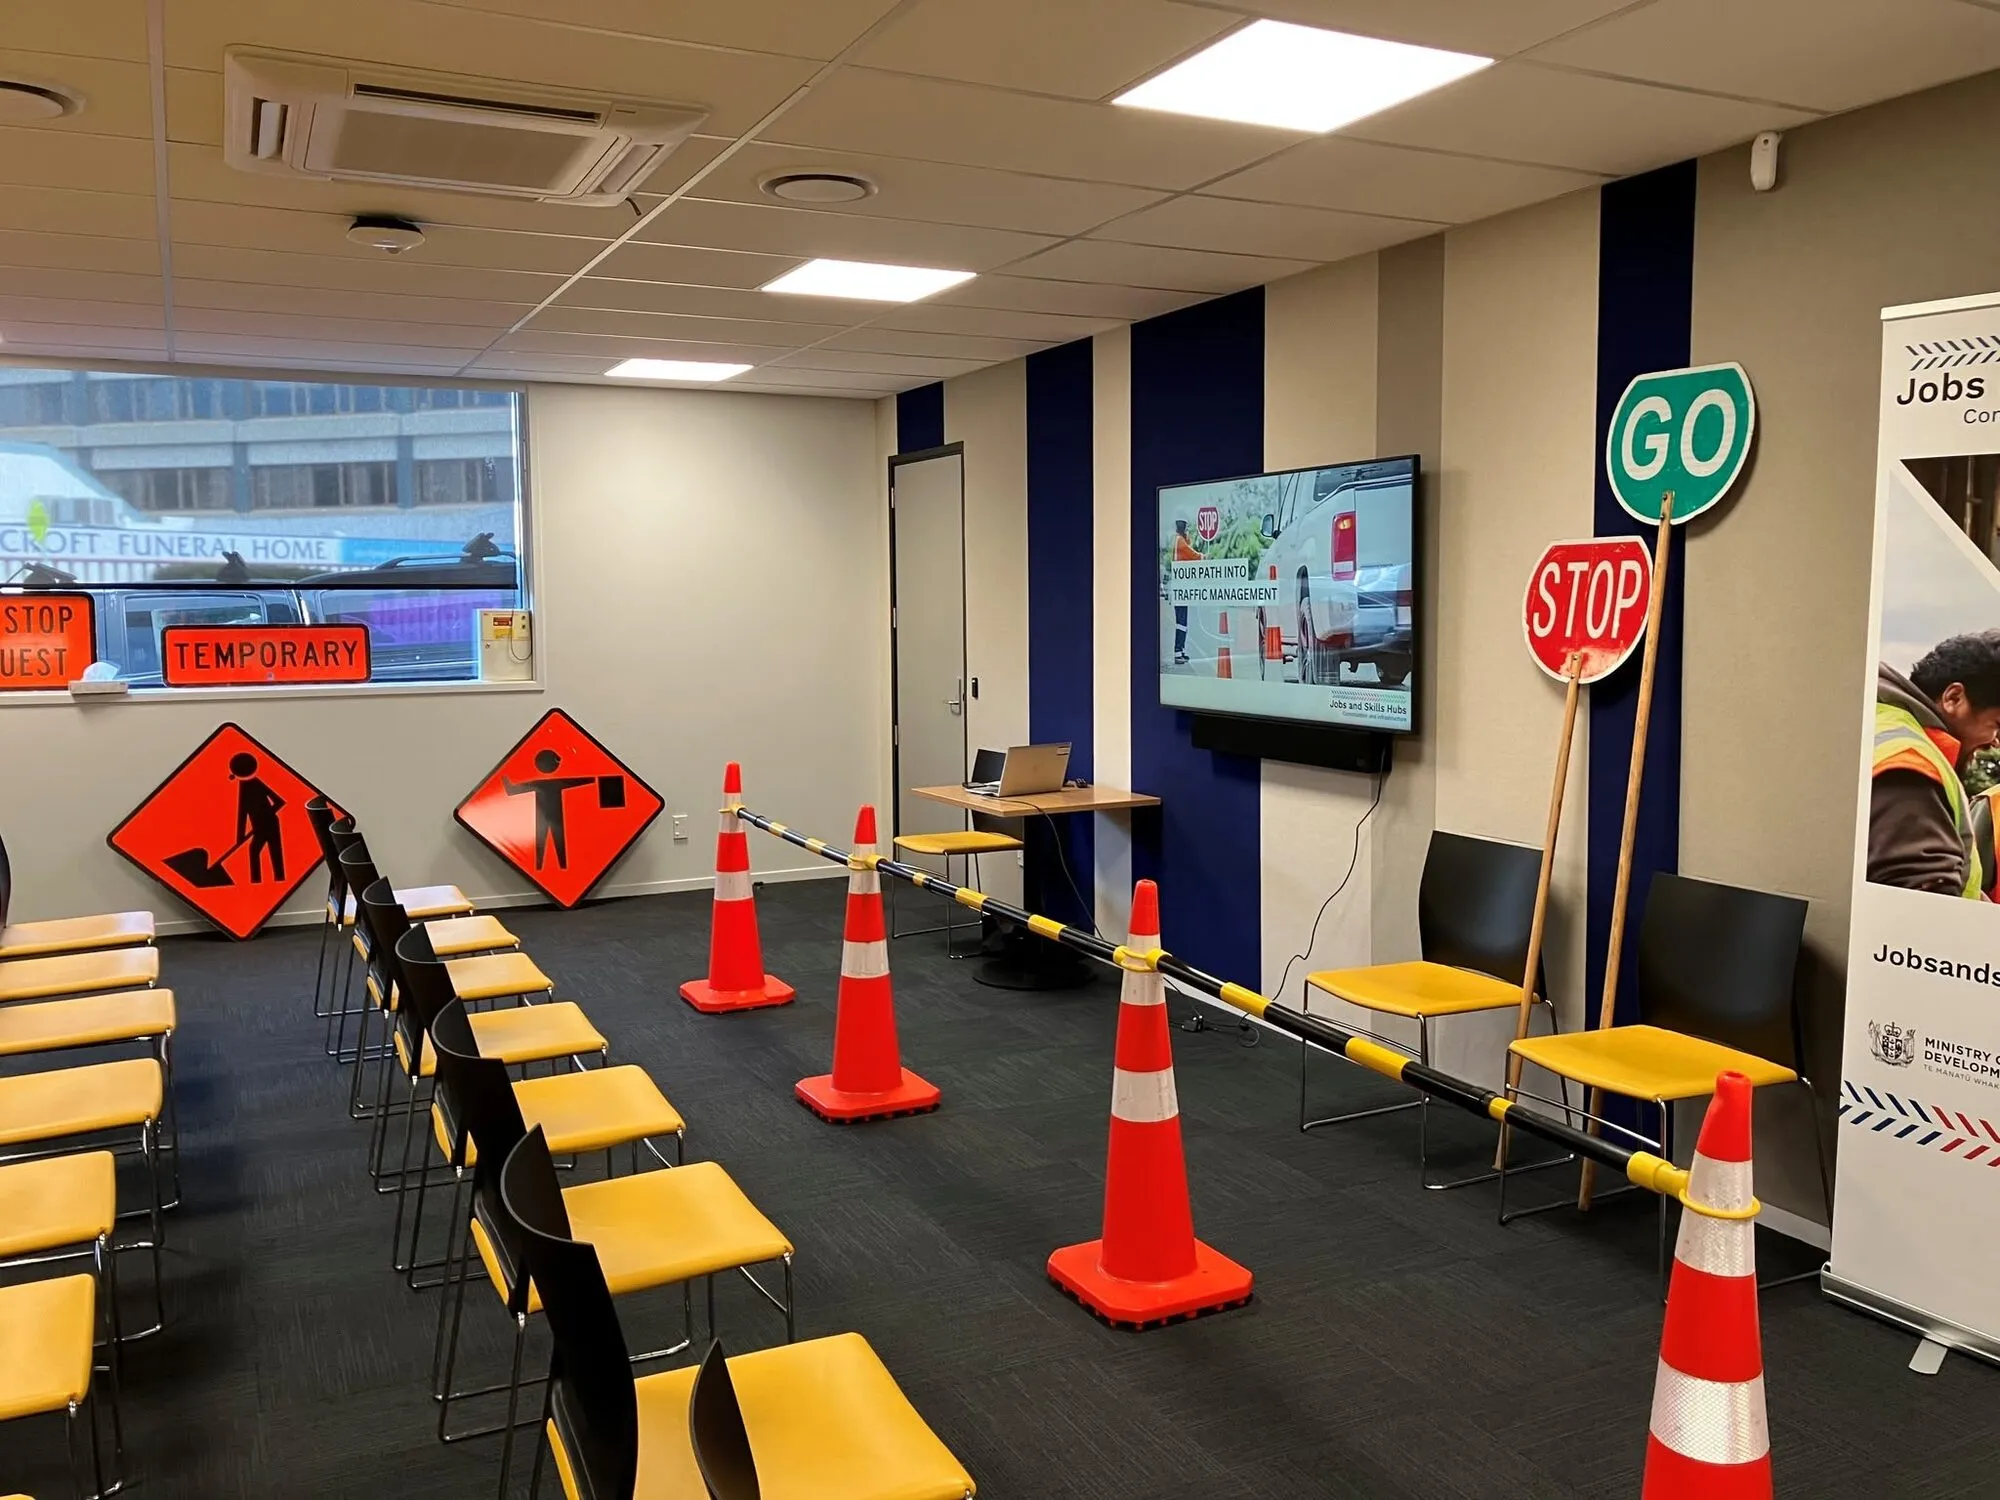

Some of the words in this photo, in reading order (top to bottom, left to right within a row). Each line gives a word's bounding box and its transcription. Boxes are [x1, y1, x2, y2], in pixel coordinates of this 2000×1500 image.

[1896, 372, 1985, 405] Jobs
[1621, 388, 1737, 481] GO
[1199, 511, 1217, 531] STOP
[252, 539, 328, 560] HOME
[1173, 567, 1197, 580] YOUR
[1198, 566, 1222, 579] PATH
[1224, 565, 1247, 578] INTO
[1173, 588, 1208, 601] TRAFFIC
[1209, 587, 1278, 601] MANAGEMENT
[1532, 559, 1643, 639] STOP
[4, 605, 73, 634] STOP
[0, 648, 67, 677] UEST
[174, 640, 358, 670] TEMPORARY
[1329, 700, 1347, 709] Jobs
[1348, 702, 1362, 711] and
[1364, 703, 1385, 713] Skills
[1386, 704, 1407, 715] Hubs
[1925, 1037, 1992, 1062] MINISTRY
[1924, 1050, 2000, 1079] DEVELOPM
[1924, 1063, 1934, 1072] TE
